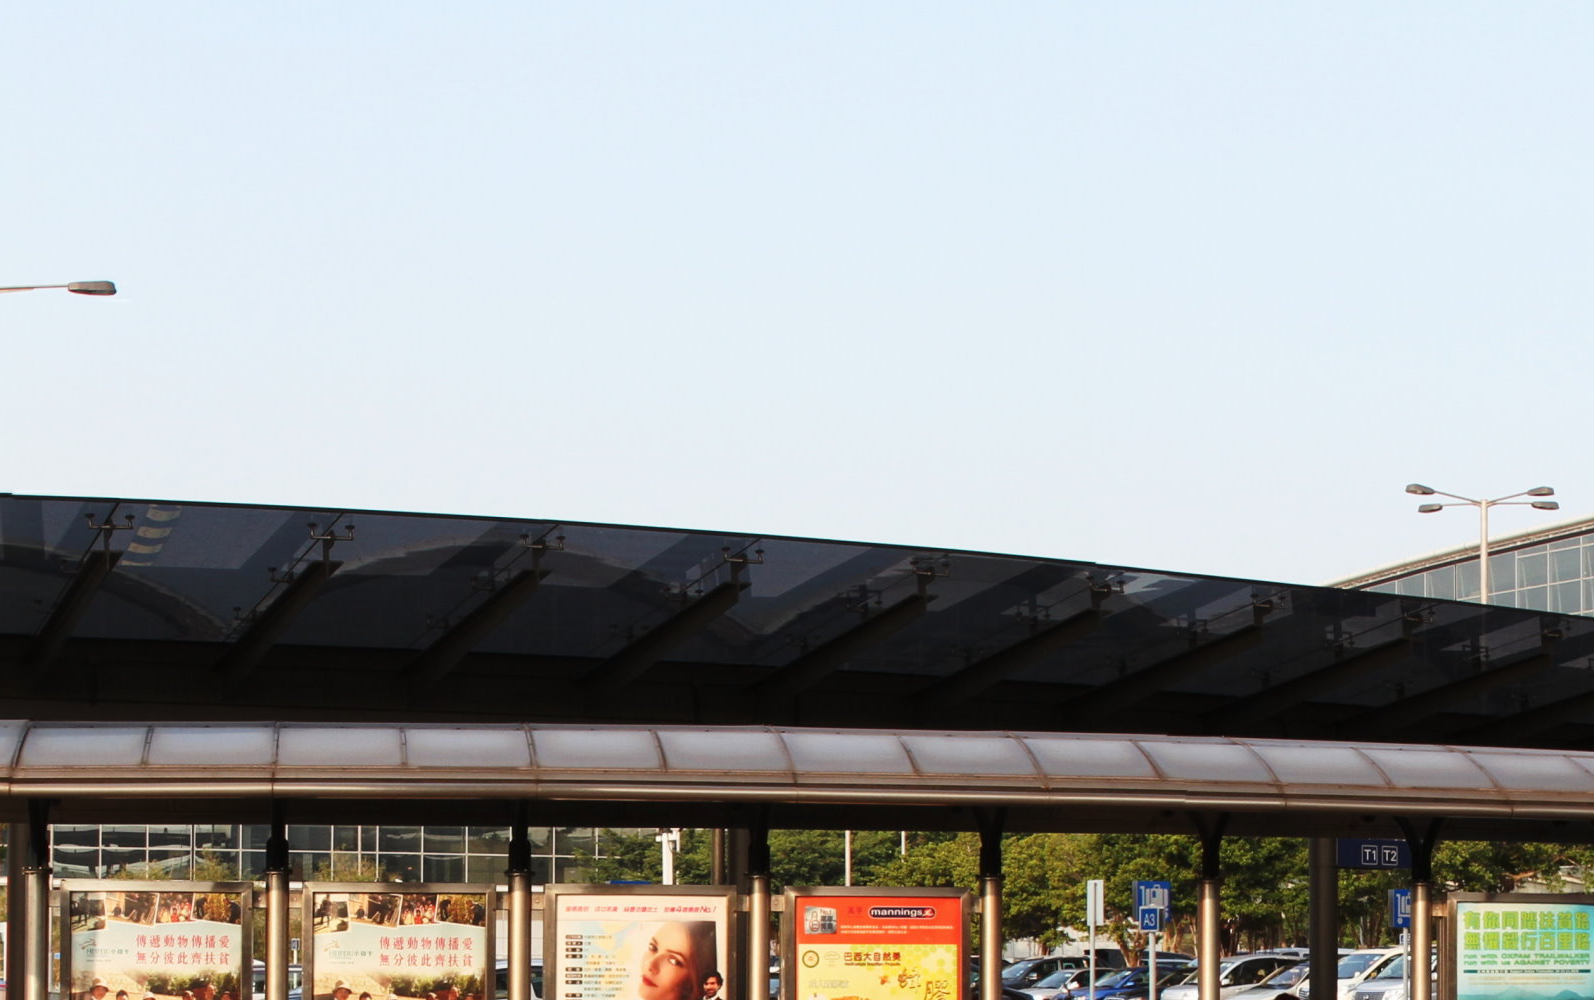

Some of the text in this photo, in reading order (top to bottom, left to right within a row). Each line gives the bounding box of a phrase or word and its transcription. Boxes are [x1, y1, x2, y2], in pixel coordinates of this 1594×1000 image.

[1363, 848, 1398, 863] T1 T2
[870, 907, 923, 918] mannings
[1143, 914, 1156, 926] A3
[136, 934, 231, 949] 傳遞動物傳播愛
[379, 936, 474, 950] 傳遞動物傳播愛
[135, 951, 231, 965] 無分彼此齊扶貧
[379, 953, 474, 968] 無分彼此齊扶貧
